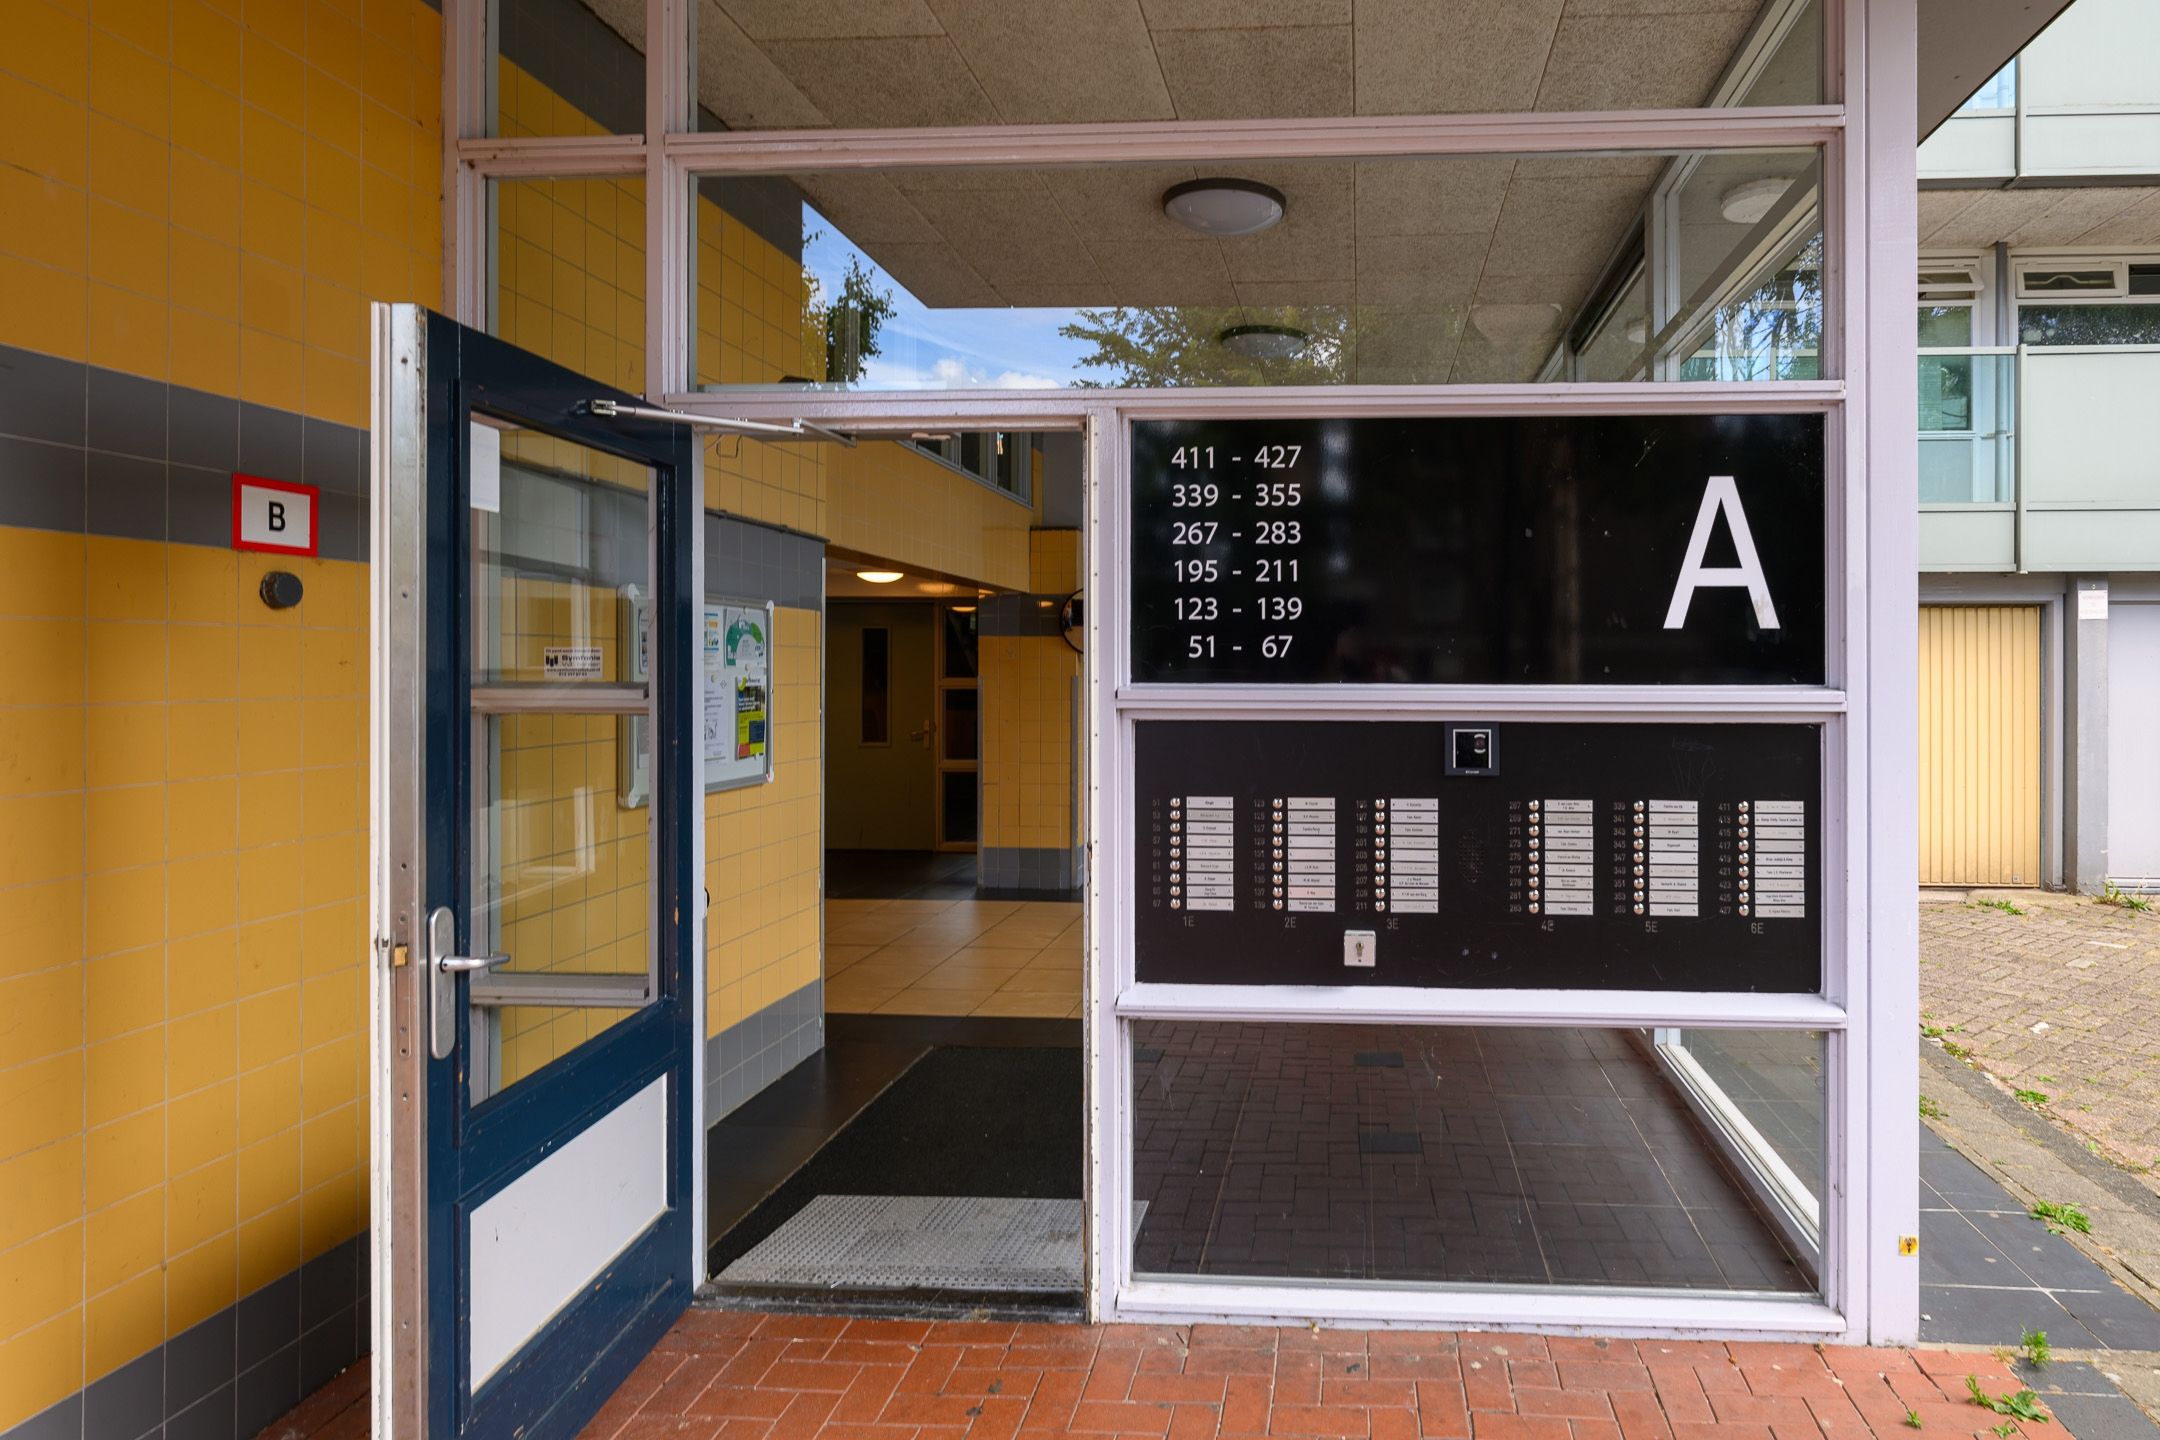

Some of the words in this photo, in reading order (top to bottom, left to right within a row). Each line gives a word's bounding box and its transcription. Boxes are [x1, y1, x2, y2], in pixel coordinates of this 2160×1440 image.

[1171, 446, 1214, 469] 411
[1254, 445, 1302, 469] 427
[1172, 483, 1219, 507] 339
[1255, 483, 1301, 507] 355
[268, 501, 286, 532] B
[1172, 521, 1219, 545] 267
[1255, 521, 1301, 545] 283
[1664, 476, 1780, 628] A
[1174, 559, 1218, 583] 195
[1255, 559, 1298, 582] 211
[1174, 597, 1218, 621] 123
[1257, 597, 1303, 620] 139
[1188, 635, 1215, 659] 51
[1261, 635, 1293, 658] 67
[1183, 915, 1195, 927] 1E
[1284, 916, 1297, 929] 2E
[1386, 917, 1399, 930] 3E
[1541, 919, 1554, 932] 4E
[1645, 920, 1658, 933] 5E
[1750, 922, 1764, 935] 6E
